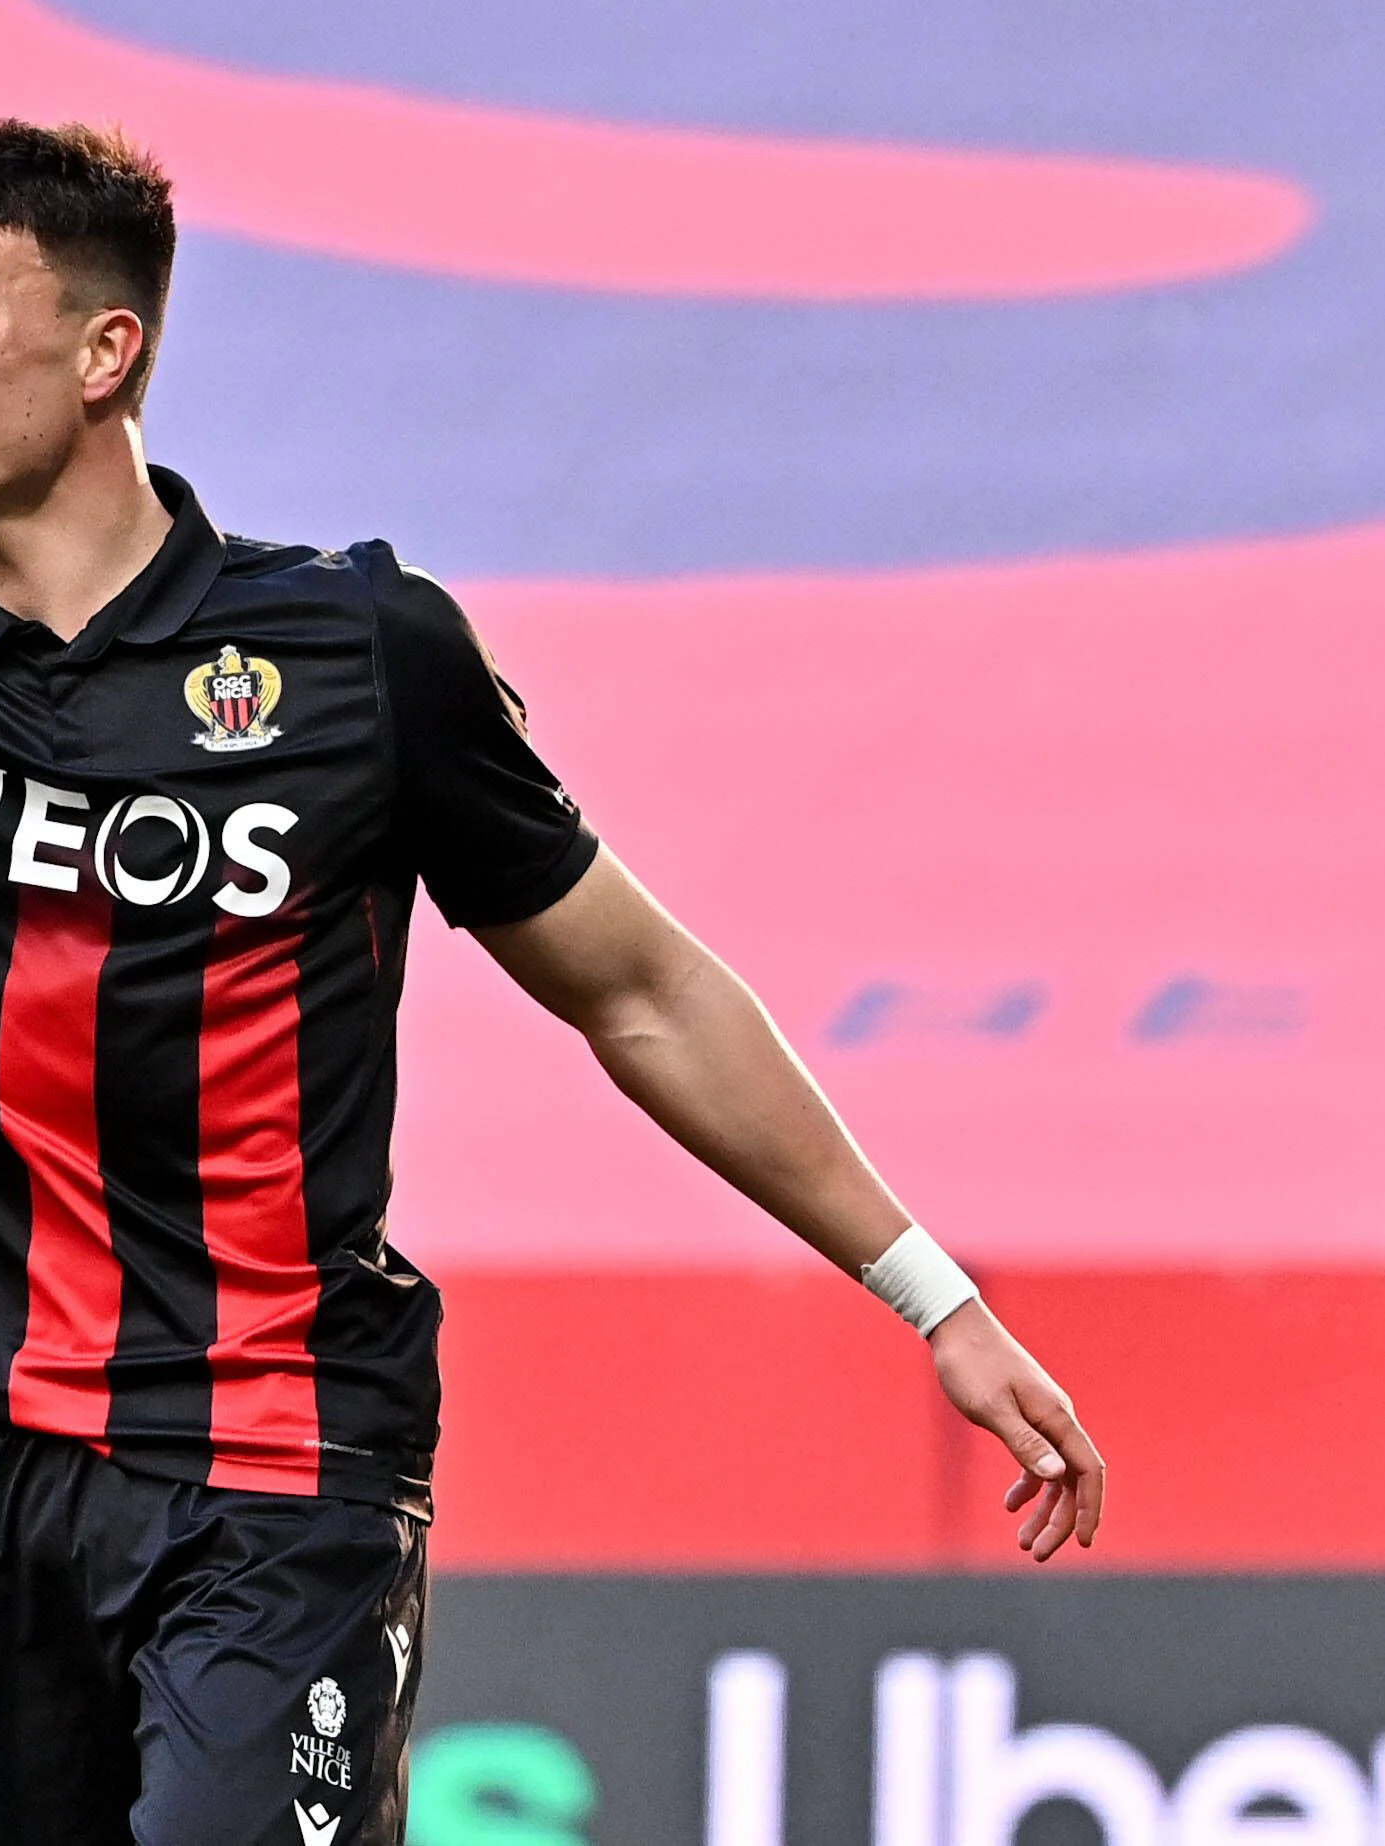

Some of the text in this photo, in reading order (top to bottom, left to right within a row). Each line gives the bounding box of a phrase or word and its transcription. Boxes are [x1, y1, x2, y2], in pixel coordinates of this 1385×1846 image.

[212, 675, 251, 690] OGC
[214, 686, 253, 701] NICE
[290, 1732, 352, 1767] VILLE DE
[706, 1648, 1385, 1846] Ube
[289, 1749, 353, 1791] NICE
